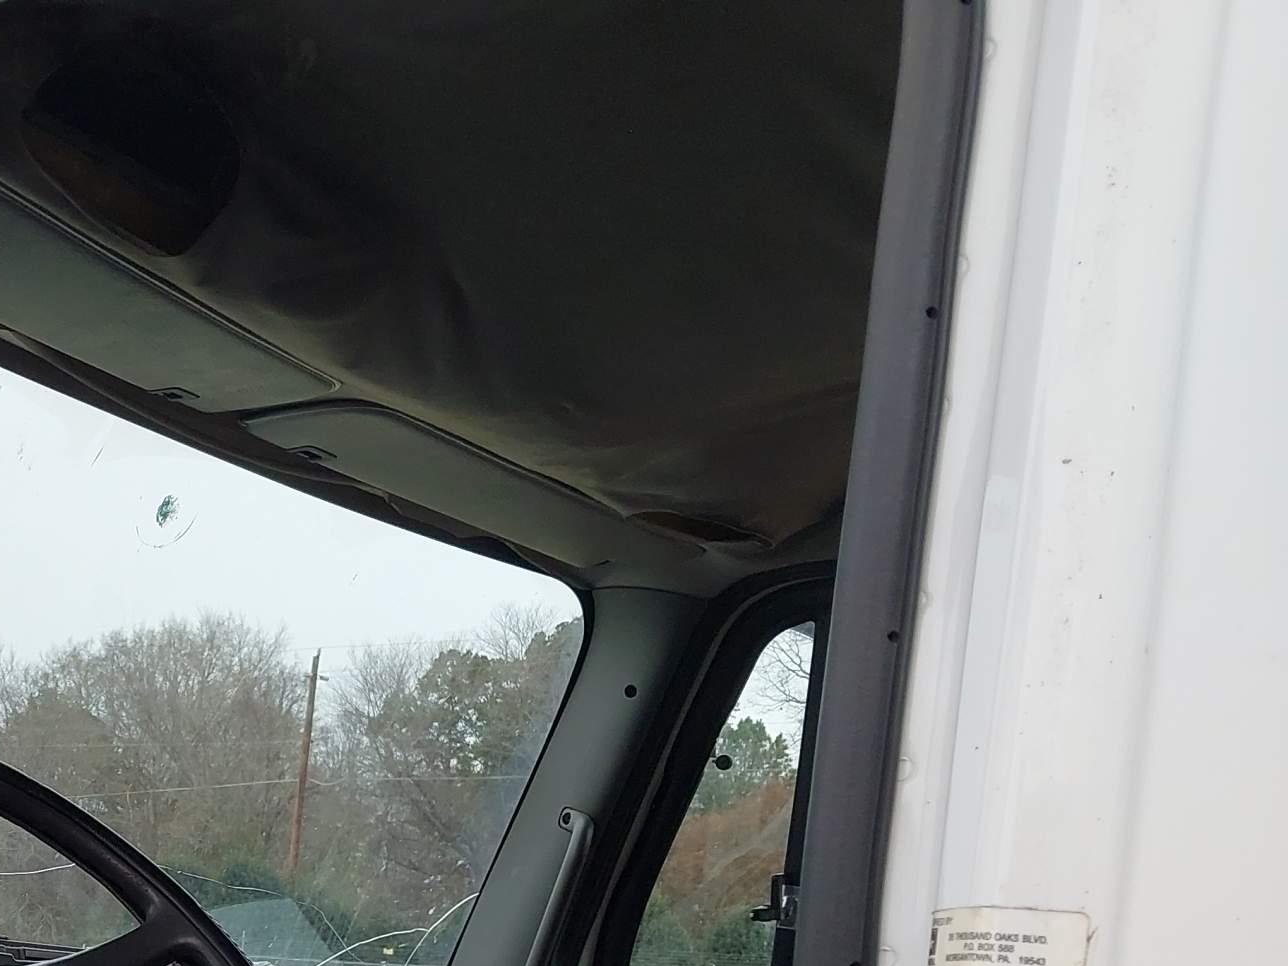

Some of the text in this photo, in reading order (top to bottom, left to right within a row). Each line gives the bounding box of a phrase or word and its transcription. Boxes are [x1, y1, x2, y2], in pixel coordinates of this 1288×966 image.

[994, 932, 1019, 943] OAKS
[1021, 934, 1048, 945] BLVD.
[977, 943, 995, 952] BOX
[1018, 956, 1047, 966] 19543
